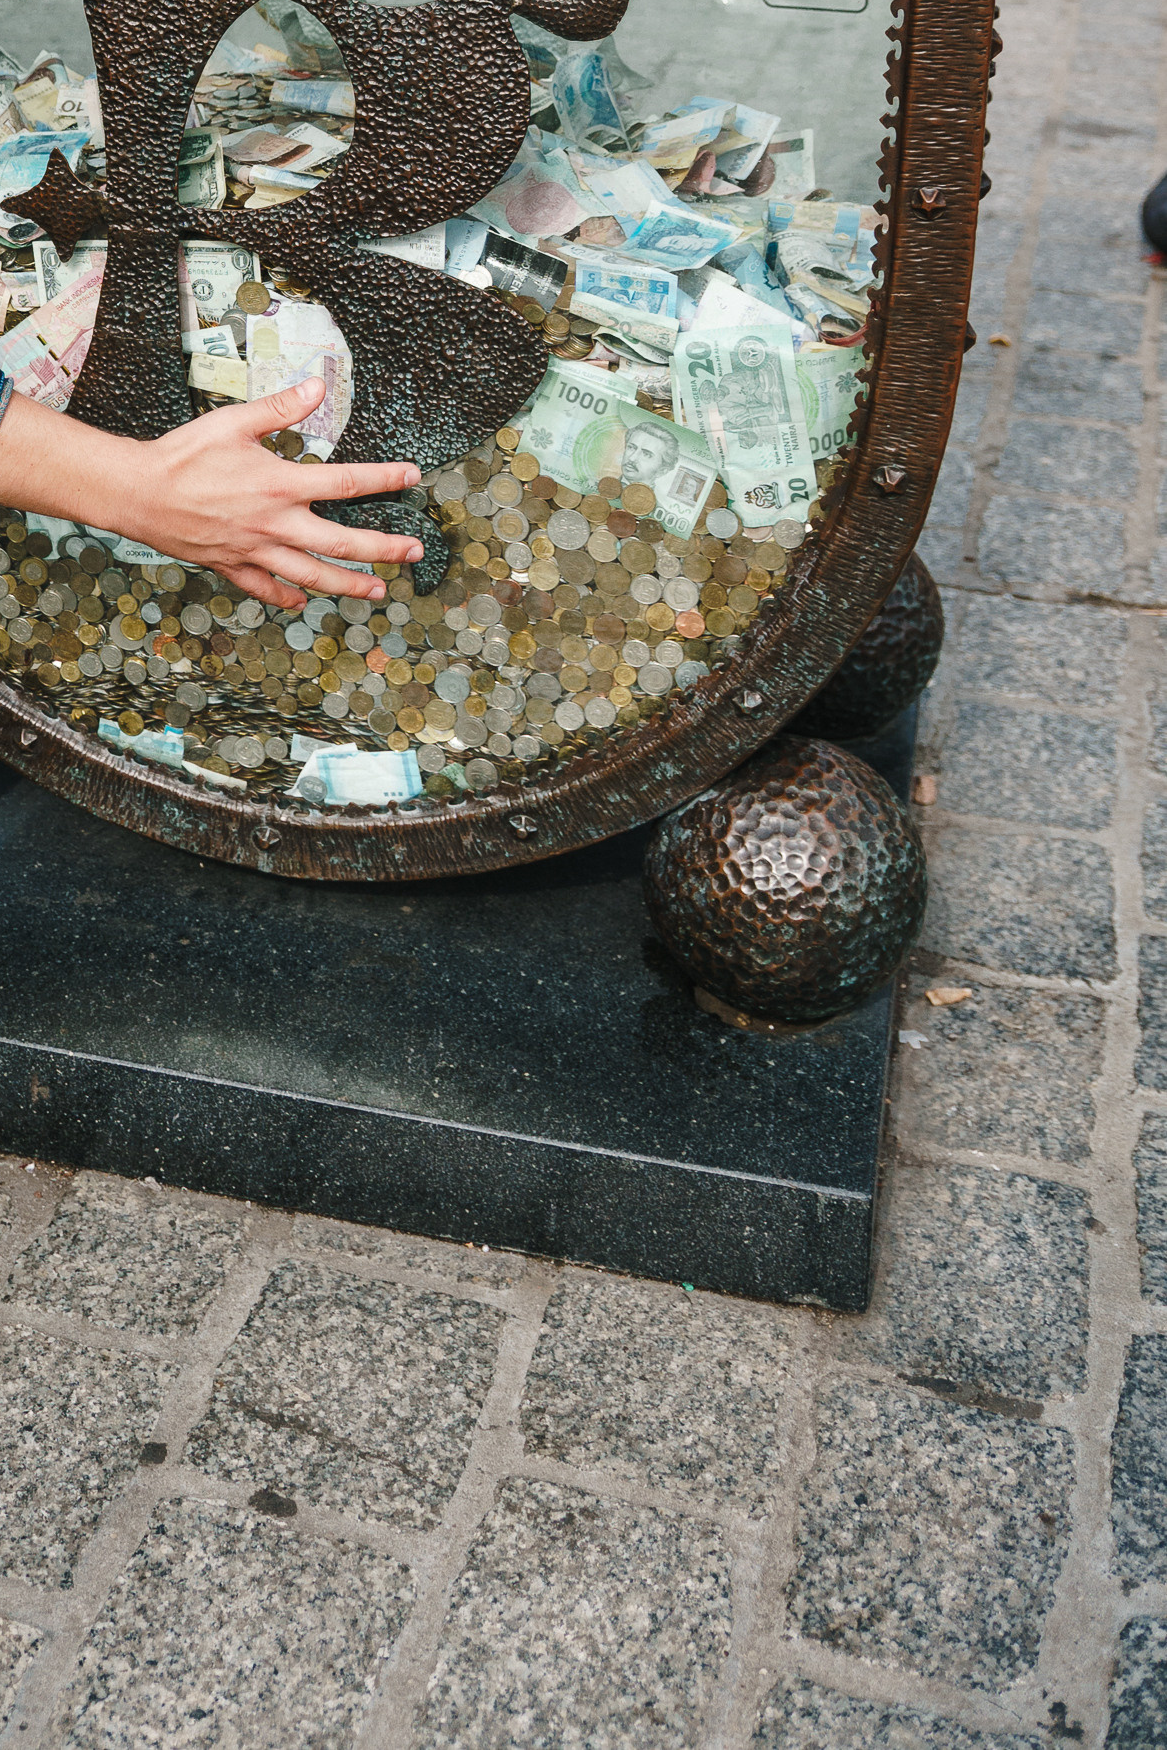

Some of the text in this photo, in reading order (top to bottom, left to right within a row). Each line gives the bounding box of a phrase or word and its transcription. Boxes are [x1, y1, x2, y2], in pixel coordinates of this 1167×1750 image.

[685, 341, 716, 378] 20
[557, 381, 609, 416] 1000
[690, 379, 702, 408] NIGERIA
[782, 431, 794, 465] TWENTY
[788, 424, 800, 451] NAIRA
[788, 477, 809, 503] 20
